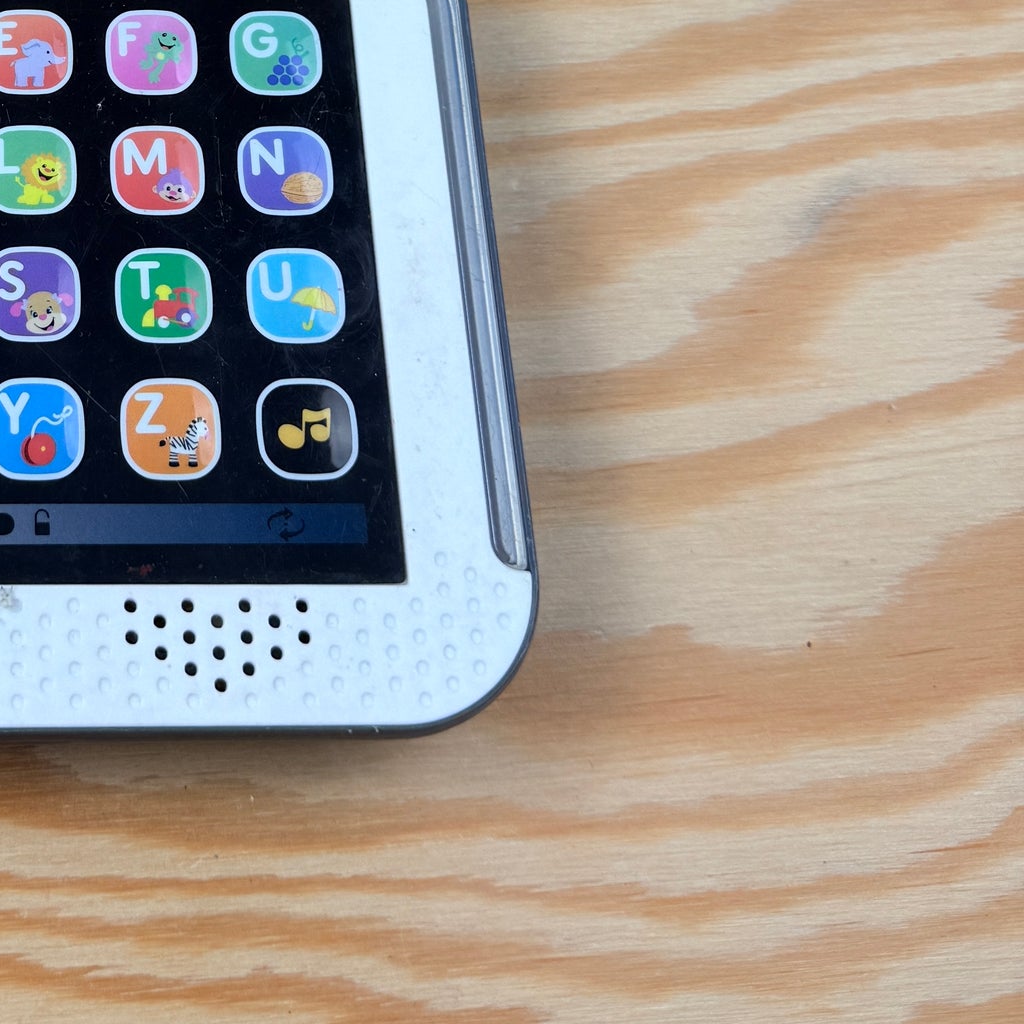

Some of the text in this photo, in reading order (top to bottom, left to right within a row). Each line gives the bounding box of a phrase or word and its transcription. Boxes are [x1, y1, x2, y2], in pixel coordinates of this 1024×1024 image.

[117, 22, 141, 57] F
[242, 22, 277, 58] G
[123, 138, 166, 175] M
[249, 138, 285, 176] N
[128, 261, 160, 299] T
[259, 261, 292, 301] U
[0, 392, 30, 434] Y
[134, 393, 166, 434] Z
